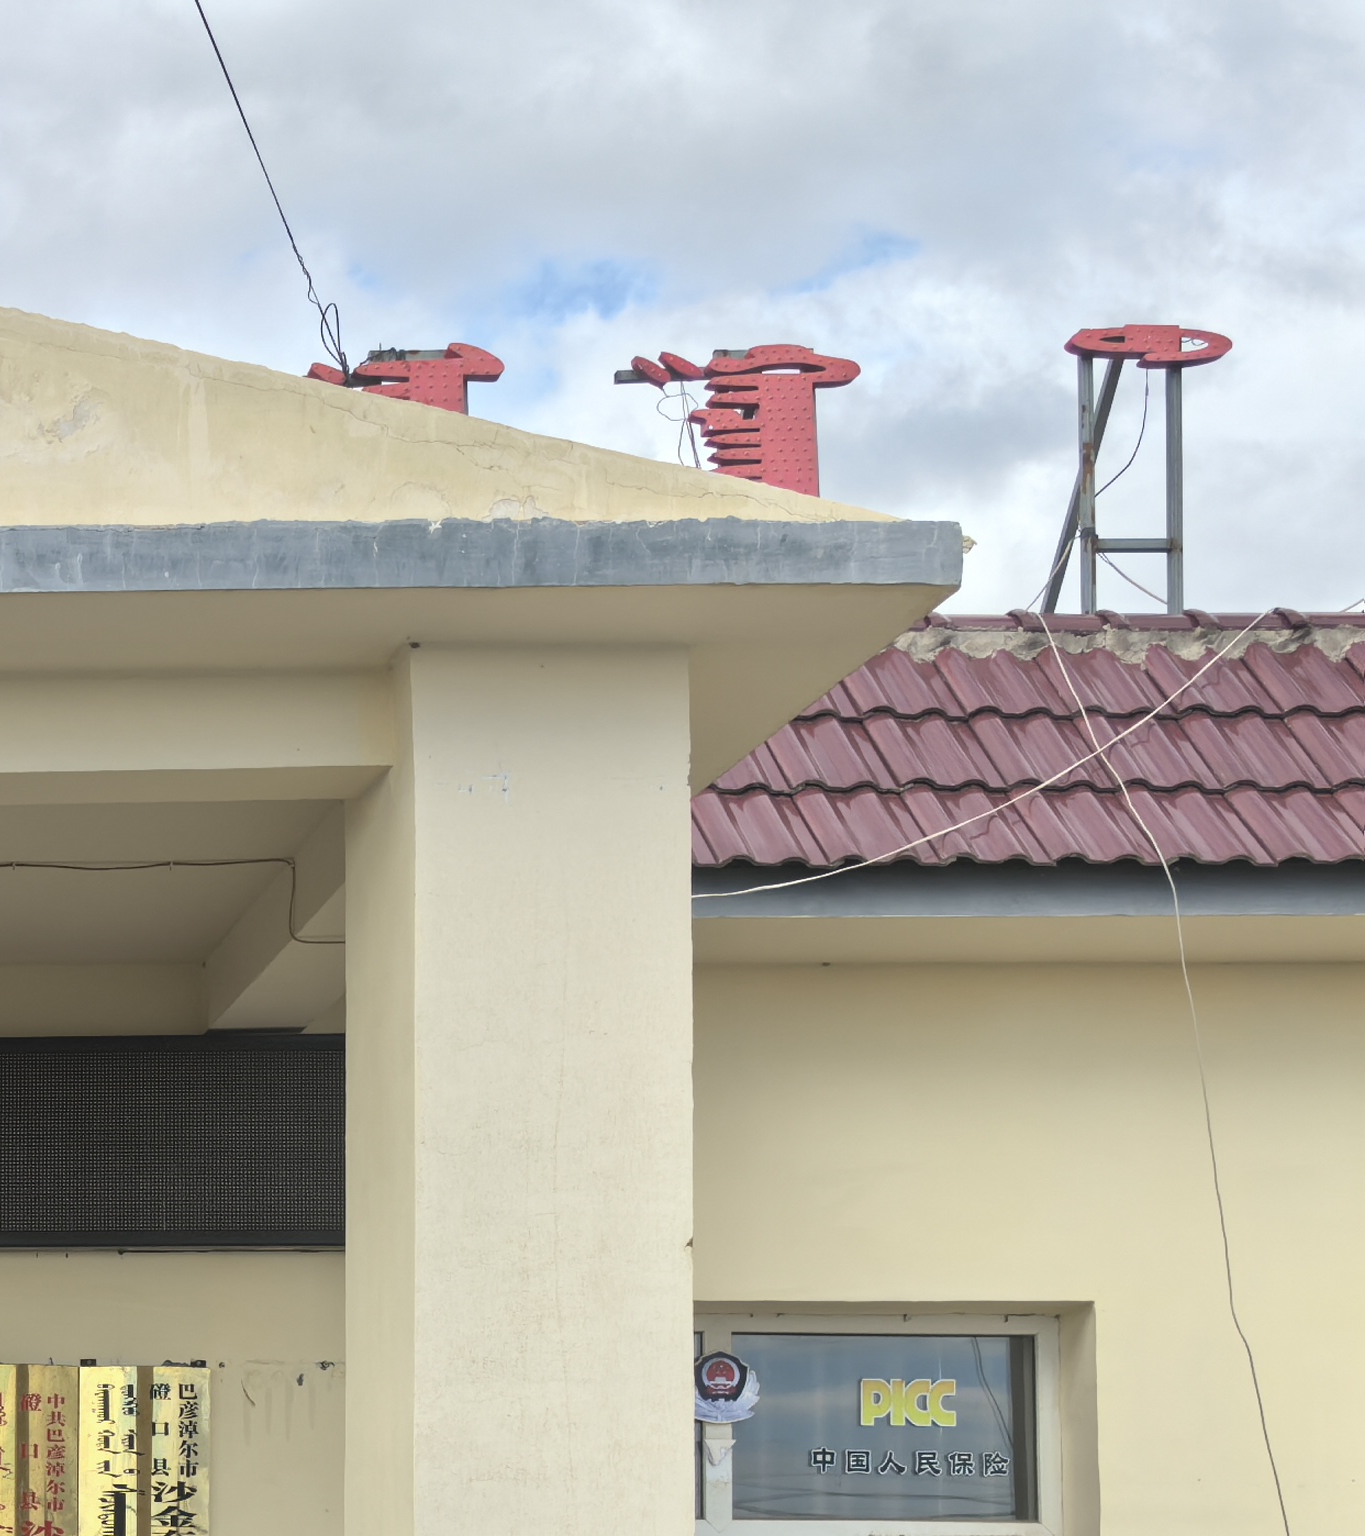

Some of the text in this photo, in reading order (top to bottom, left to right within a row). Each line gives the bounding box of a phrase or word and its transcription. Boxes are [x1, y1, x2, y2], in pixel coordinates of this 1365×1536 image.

[149, 1383, 172, 1477] 磴口县
[177, 1383, 200, 1479] 巴彦淖尔市
[859, 1378, 957, 1428] PICC
[20, 1392, 42, 1511] 磴口县
[45, 1392, 66, 1513] 中共巴彦淖尔市
[809, 1446, 1011, 1478] 中国人民保险
